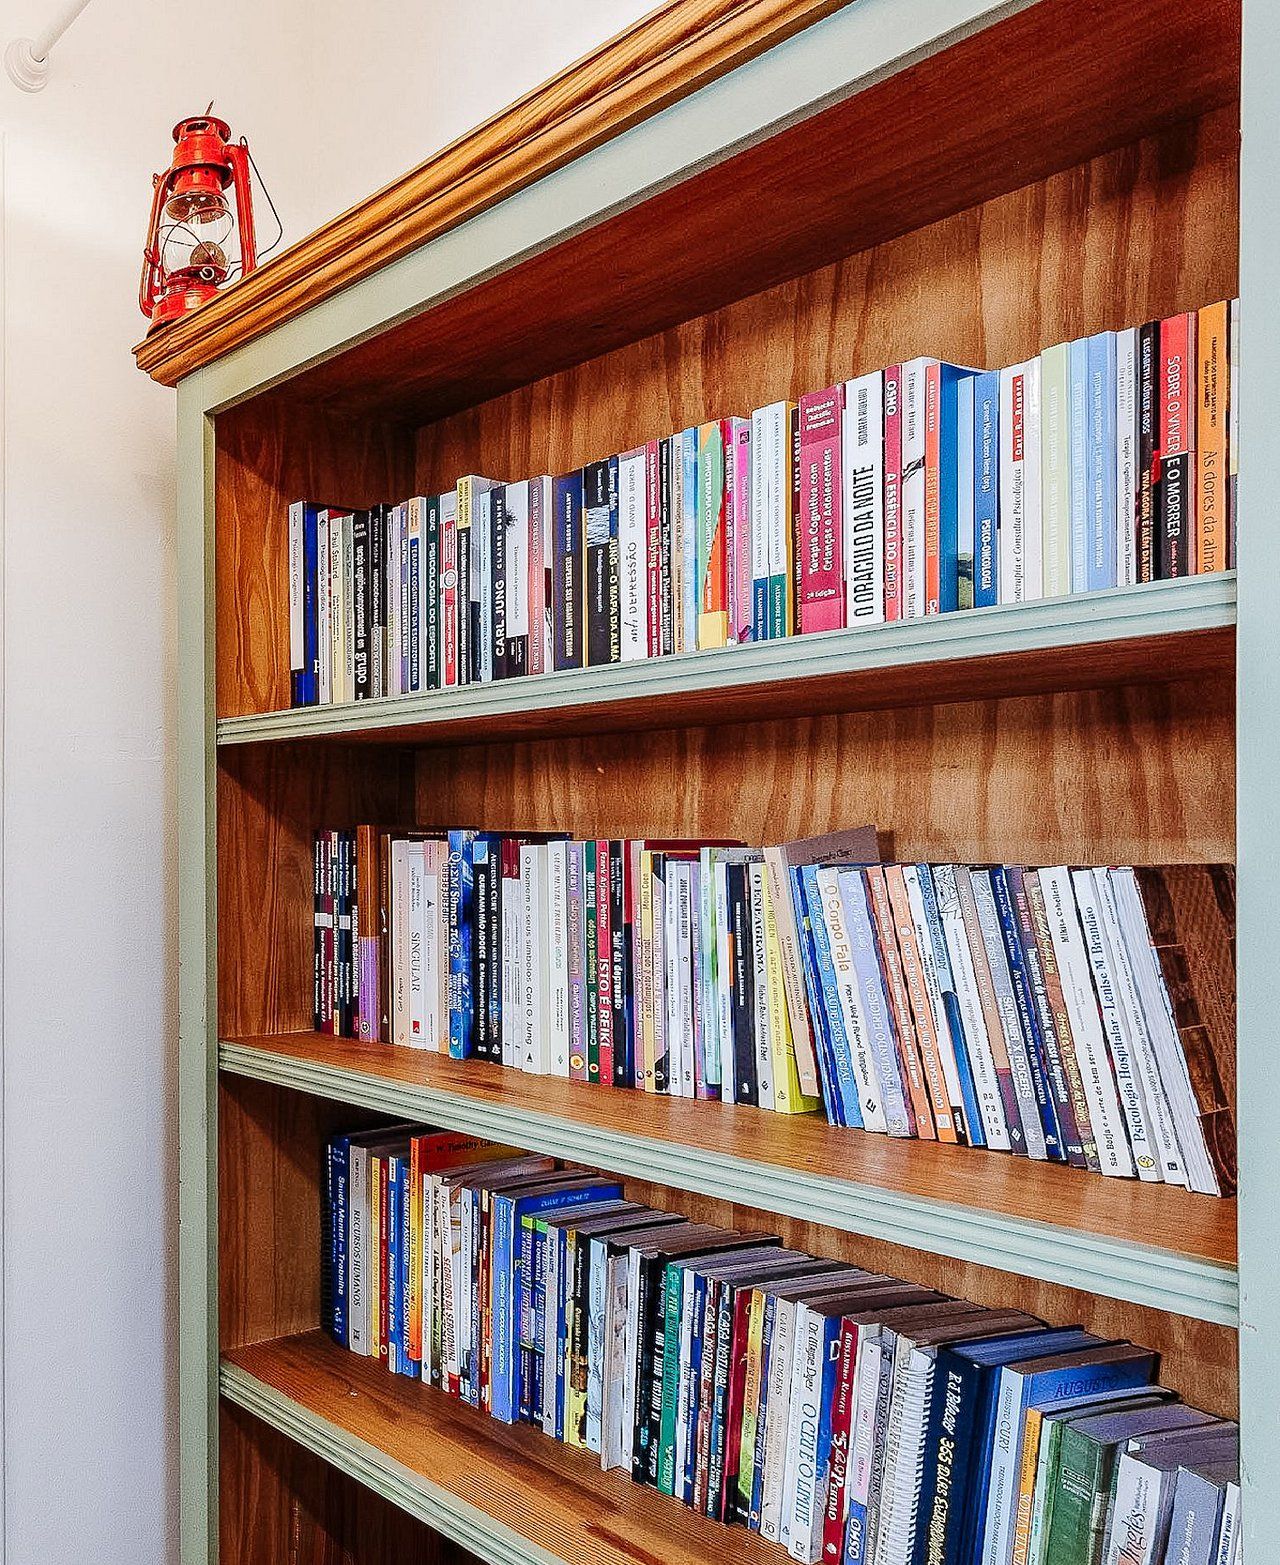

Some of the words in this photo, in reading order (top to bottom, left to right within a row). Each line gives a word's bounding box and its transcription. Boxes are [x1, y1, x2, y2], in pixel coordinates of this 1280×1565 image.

[1142, 338, 1151, 380] ELISABETH
[1167, 356, 1180, 399] SOBRE
[886, 381, 897, 416] OSHO
[1142, 381, 1151, 435] KÜBLER-ROSS
[1167, 402, 1180, 412] O
[1167, 414, 1180, 453] VIVER
[810, 463, 819, 485] com
[1167, 459, 1179, 468] E
[1167, 470, 1179, 480] O
[1203, 451, 1217, 467] As
[822, 448, 833, 516] Adolescentes
[852, 463, 874, 507] NOITE
[886, 473, 896, 483] A
[1142, 470, 1151, 488] VIVA
[1203, 472, 1218, 512] dores
[628, 504, 636, 528] DAVID
[808, 487, 821, 534] Cognitiva
[852, 510, 874, 531] DA
[885, 484, 899, 539] ESSÊNCIA
[1142, 490, 1151, 520] AGORA
[1167, 483, 1180, 538] MORRER
[331, 532, 339, 549] Paul
[1142, 533, 1152, 550] ALÉM
[1203, 517, 1217, 535] da
[319, 544, 327, 582] Psicologia
[331, 550, 340, 579] Stallard
[808, 536, 820, 574] Terapia
[822, 528, 834, 570] Crianças
[885, 542, 897, 561] DO
[981, 518, 992, 590] PSICO-ONCOLOGIA
[1142, 551, 1151, 563] DA
[1203, 539, 1217, 573] alma
[429, 542, 437, 607] PSICOLOGIA
[626, 542, 637, 614] DEPRESSÃO
[850, 534, 874, 603] ORÁCULO
[885, 563, 897, 600] AMOR
[1142, 565, 1151, 584] MOR
[495, 580, 505, 616] JUNG
[852, 605, 874, 617] O
[411, 617, 418, 626] DA
[429, 608, 436, 624] DO
[429, 625, 437, 673] ESPORTE
[495, 620, 505, 656] CARL
[532, 619, 540, 650] HANSON
[524, 856, 532, 865] O
[600, 851, 608, 874] Frank
[524, 867, 532, 902] homem
[599, 876, 608, 902] Arjava
[754, 874, 761, 884] O
[825, 885, 838, 895] O
[600, 903, 608, 929] Petter
[827, 898, 845, 940] Corpo
[926, 902, 938, 926] Redes
[613, 931, 622, 949] Sair
[753, 889, 765, 974] ENEAGRAMA
[1085, 907, 1102, 955] Brandão
[524, 939, 533, 982] símbolos
[836, 944, 850, 971] Fala
[931, 927, 946, 970] Articulando
[1095, 957, 1106, 970] M.
[599, 957, 610, 990] ISTO
[524, 986, 533, 1006] Carl
[599, 996, 612, 1004] É
[865, 976, 883, 1030] ERICKSON
[912, 989, 924, 1011] FILHO
[1101, 973, 1116, 1011] Lenise
[524, 1009, 533, 1020] G.
[572, 1009, 580, 1045] CRISTINA
[599, 1009, 610, 1048] REIKI
[918, 1013, 927, 1028] SEU
[1006, 997, 1019, 1042] SKINNER
[524, 1022, 533, 1046] Jung
[825, 985, 839, 1019] SAÚDE
[832, 1021, 850, 1083] EXISTENCIAL
[921, 1029, 931, 1048] COM
[1011, 1045, 1021, 1053] X
[1114, 1020, 1131, 1081] Hospitalar
[878, 1033, 897, 1105] VIVENCIANDO
[927, 1051, 943, 1109] CONVERSANDO
[1014, 1056, 1032, 1099] ROGERS
[1127, 1082, 1145, 1143] Psicologia
[353, 1210, 361, 1258] RECURSOS
[352, 1260, 361, 1306] HUMANOS
[444, 1257, 453, 1297] SEGREDOS
[444, 1300, 453, 1310] DA
[536, 1294, 545, 1316] LUIZ
[657, 1291, 666, 1318] Luciano
[445, 1312, 456, 1361] SEROTONINA
[535, 1319, 545, 1347] ANDRÉ
[778, 1312, 788, 1338] CARL
[808, 1321, 818, 1334] Dr.
[778, 1344, 785, 1352] R.
[775, 1357, 785, 1396] ROGERS
[803, 1368, 815, 1392] Dyer
[801, 1402, 816, 1417] O
[877, 1372, 890, 1422] FRACOS
[1003, 1386, 1013, 1419] AUGUSTO
[800, 1420, 817, 1447] CÉU
[873, 1422, 886, 1465] PONTOS
[998, 1420, 1011, 1453] CURY
[798, 1463, 813, 1478] O
[871, 1467, 881, 1494] SEUS
[795, 1479, 811, 1526] LIMITE
[847, 1518, 861, 1560] OSHO
